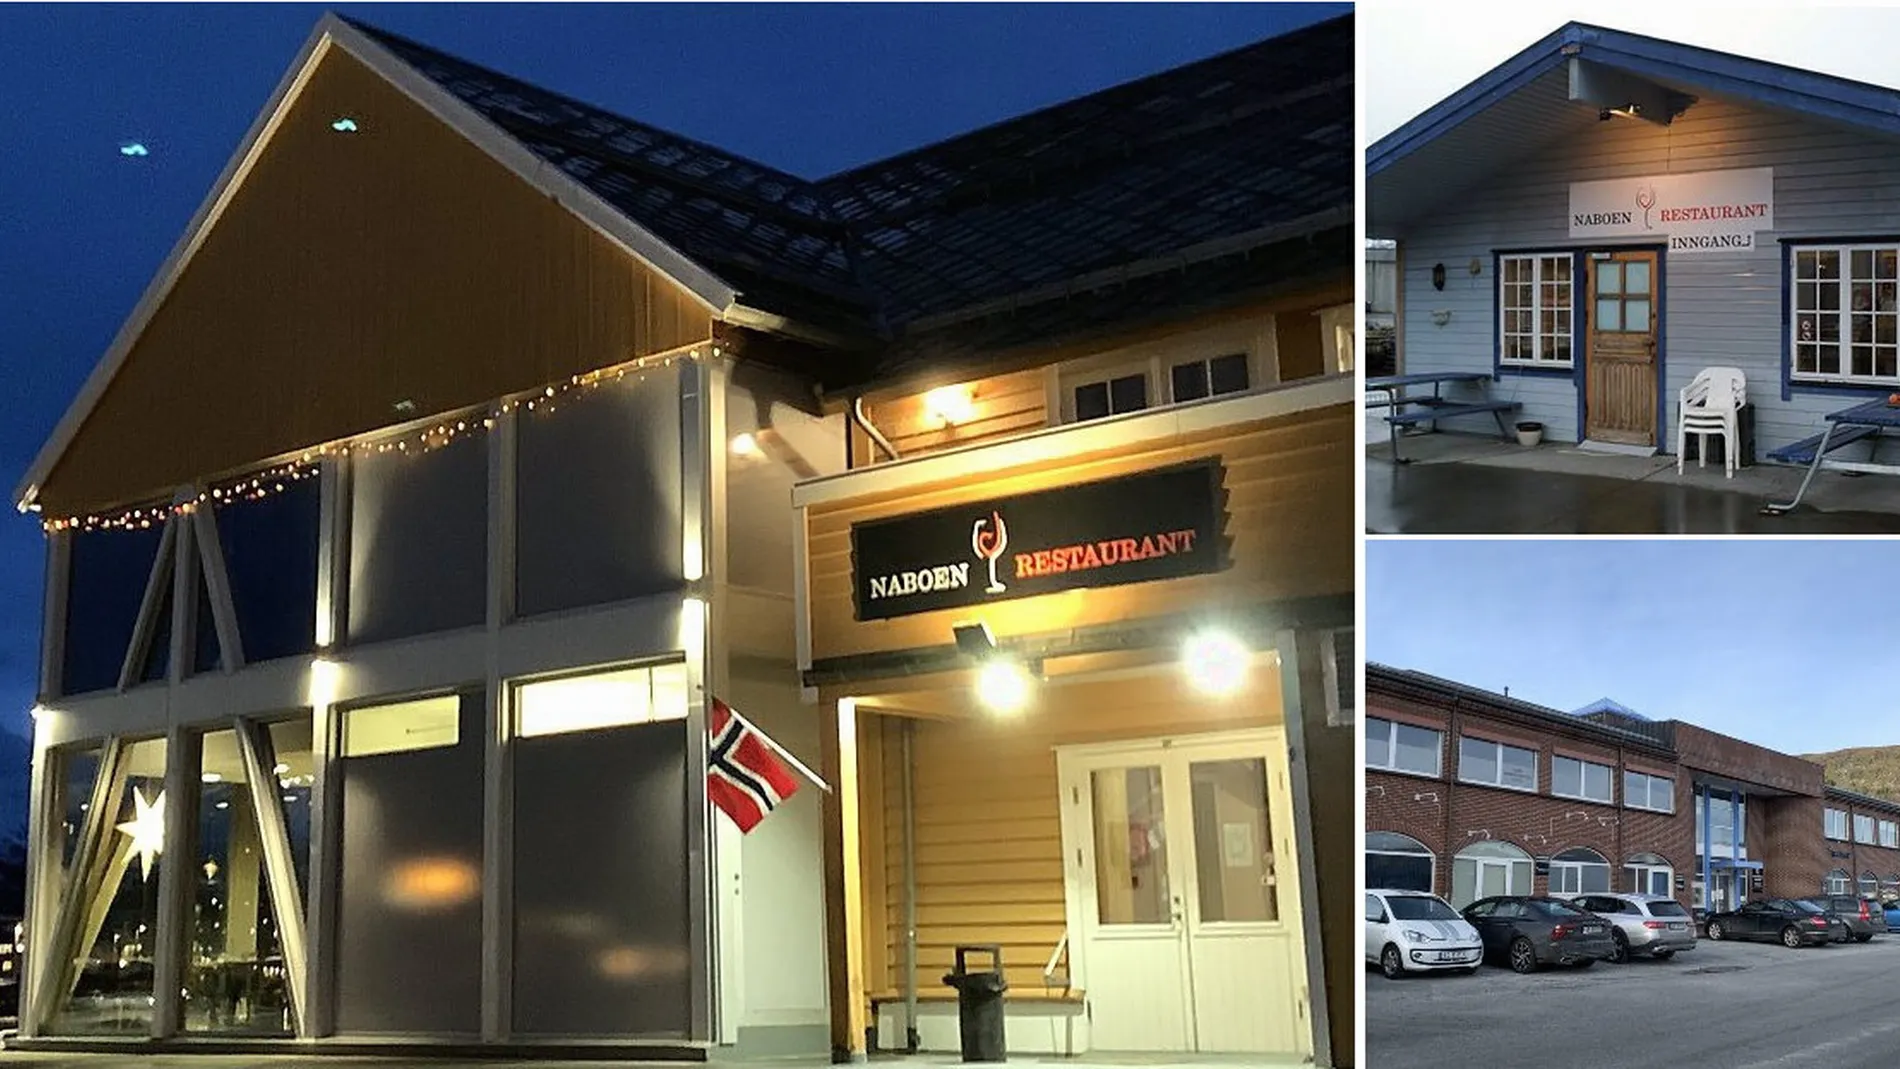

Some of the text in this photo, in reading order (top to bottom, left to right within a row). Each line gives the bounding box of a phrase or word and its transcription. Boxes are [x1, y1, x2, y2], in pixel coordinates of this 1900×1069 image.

[1574, 203, 1768, 226] NABOEN RESTAURANT
[870, 529, 1196, 599] NABOEN RESTAURANT
